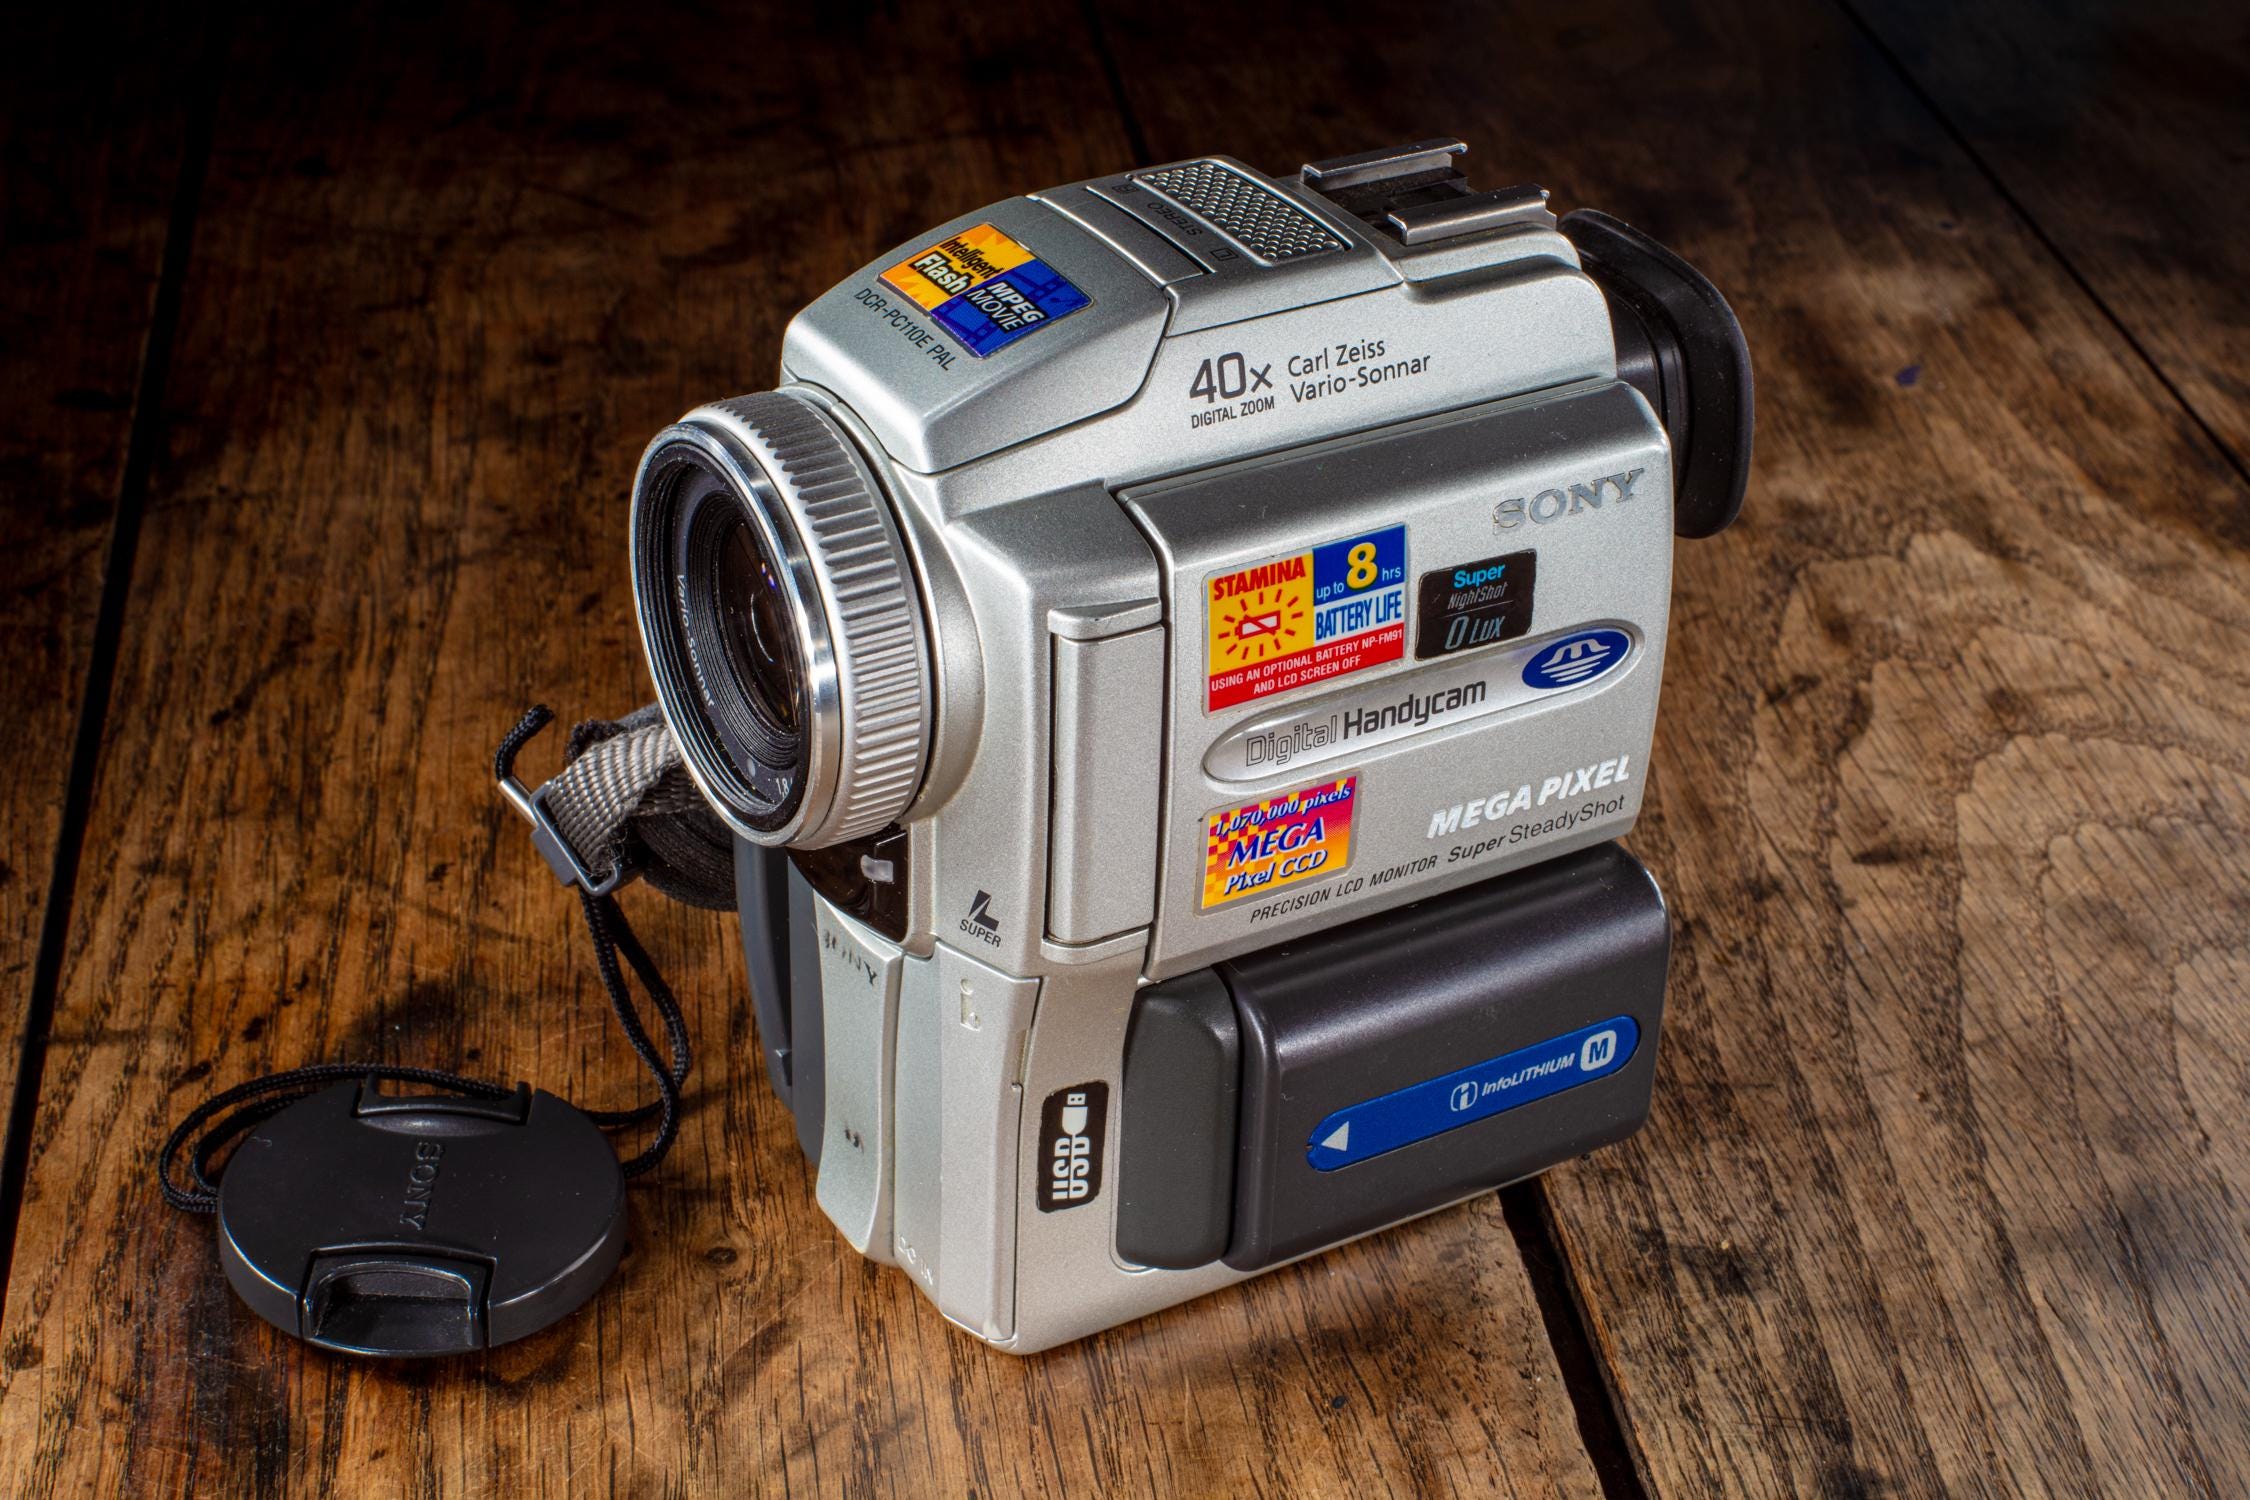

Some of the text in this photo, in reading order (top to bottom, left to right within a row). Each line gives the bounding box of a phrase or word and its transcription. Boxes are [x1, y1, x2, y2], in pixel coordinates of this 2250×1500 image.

[1147, 202, 1203, 236] STEREO
[913, 253, 972, 294] Flash
[939, 237, 1004, 278] Intelligent
[966, 289, 1025, 331] MOVIE
[986, 281, 1044, 324] MPEG
[855, 288, 957, 371] DCR-PC110E PAL
[1189, 352, 1273, 404] 40x
[1288, 339, 1386, 377] Carl Zeiss
[1290, 354, 1431, 403] Vario-Sonnar
[1190, 396, 1275, 429] DIGITAL ZOOM
[1493, 467, 1645, 535] SONY
[1213, 556, 1306, 601] STAMINA
[1316, 542, 1401, 599] up to 8 hrs
[1453, 563, 1505, 588] Super
[1315, 590, 1402, 640] BATTERY LIFE
[1447, 581, 1509, 610] NightShot
[675, 574, 716, 707] Vario-Sonnar
[1444, 616, 1469, 650] 0
[1211, 629, 1402, 692] USING AN OPTIONAL BATTERY NP-FM91
[1253, 655, 1362, 694] AND LCD SCREEN OFF
[1246, 680, 1487, 767] Digital Handycam
[1215, 784, 1352, 837] 1,070,000 pixels
[1426, 753, 1631, 839] MEGA PIXEL
[1227, 816, 1326, 869] MEGA
[1250, 794, 1625, 923] PRECISION LCD MONITOR Super SteadyShot
[1223, 850, 1328, 896] Pixel CCD
[959, 919, 1002, 948] SUPER
[1481, 1053, 1576, 1097] InfoLITHIUM
[400, 1142, 444, 1231] SONY
[1052, 1135, 1091, 1200] USB
